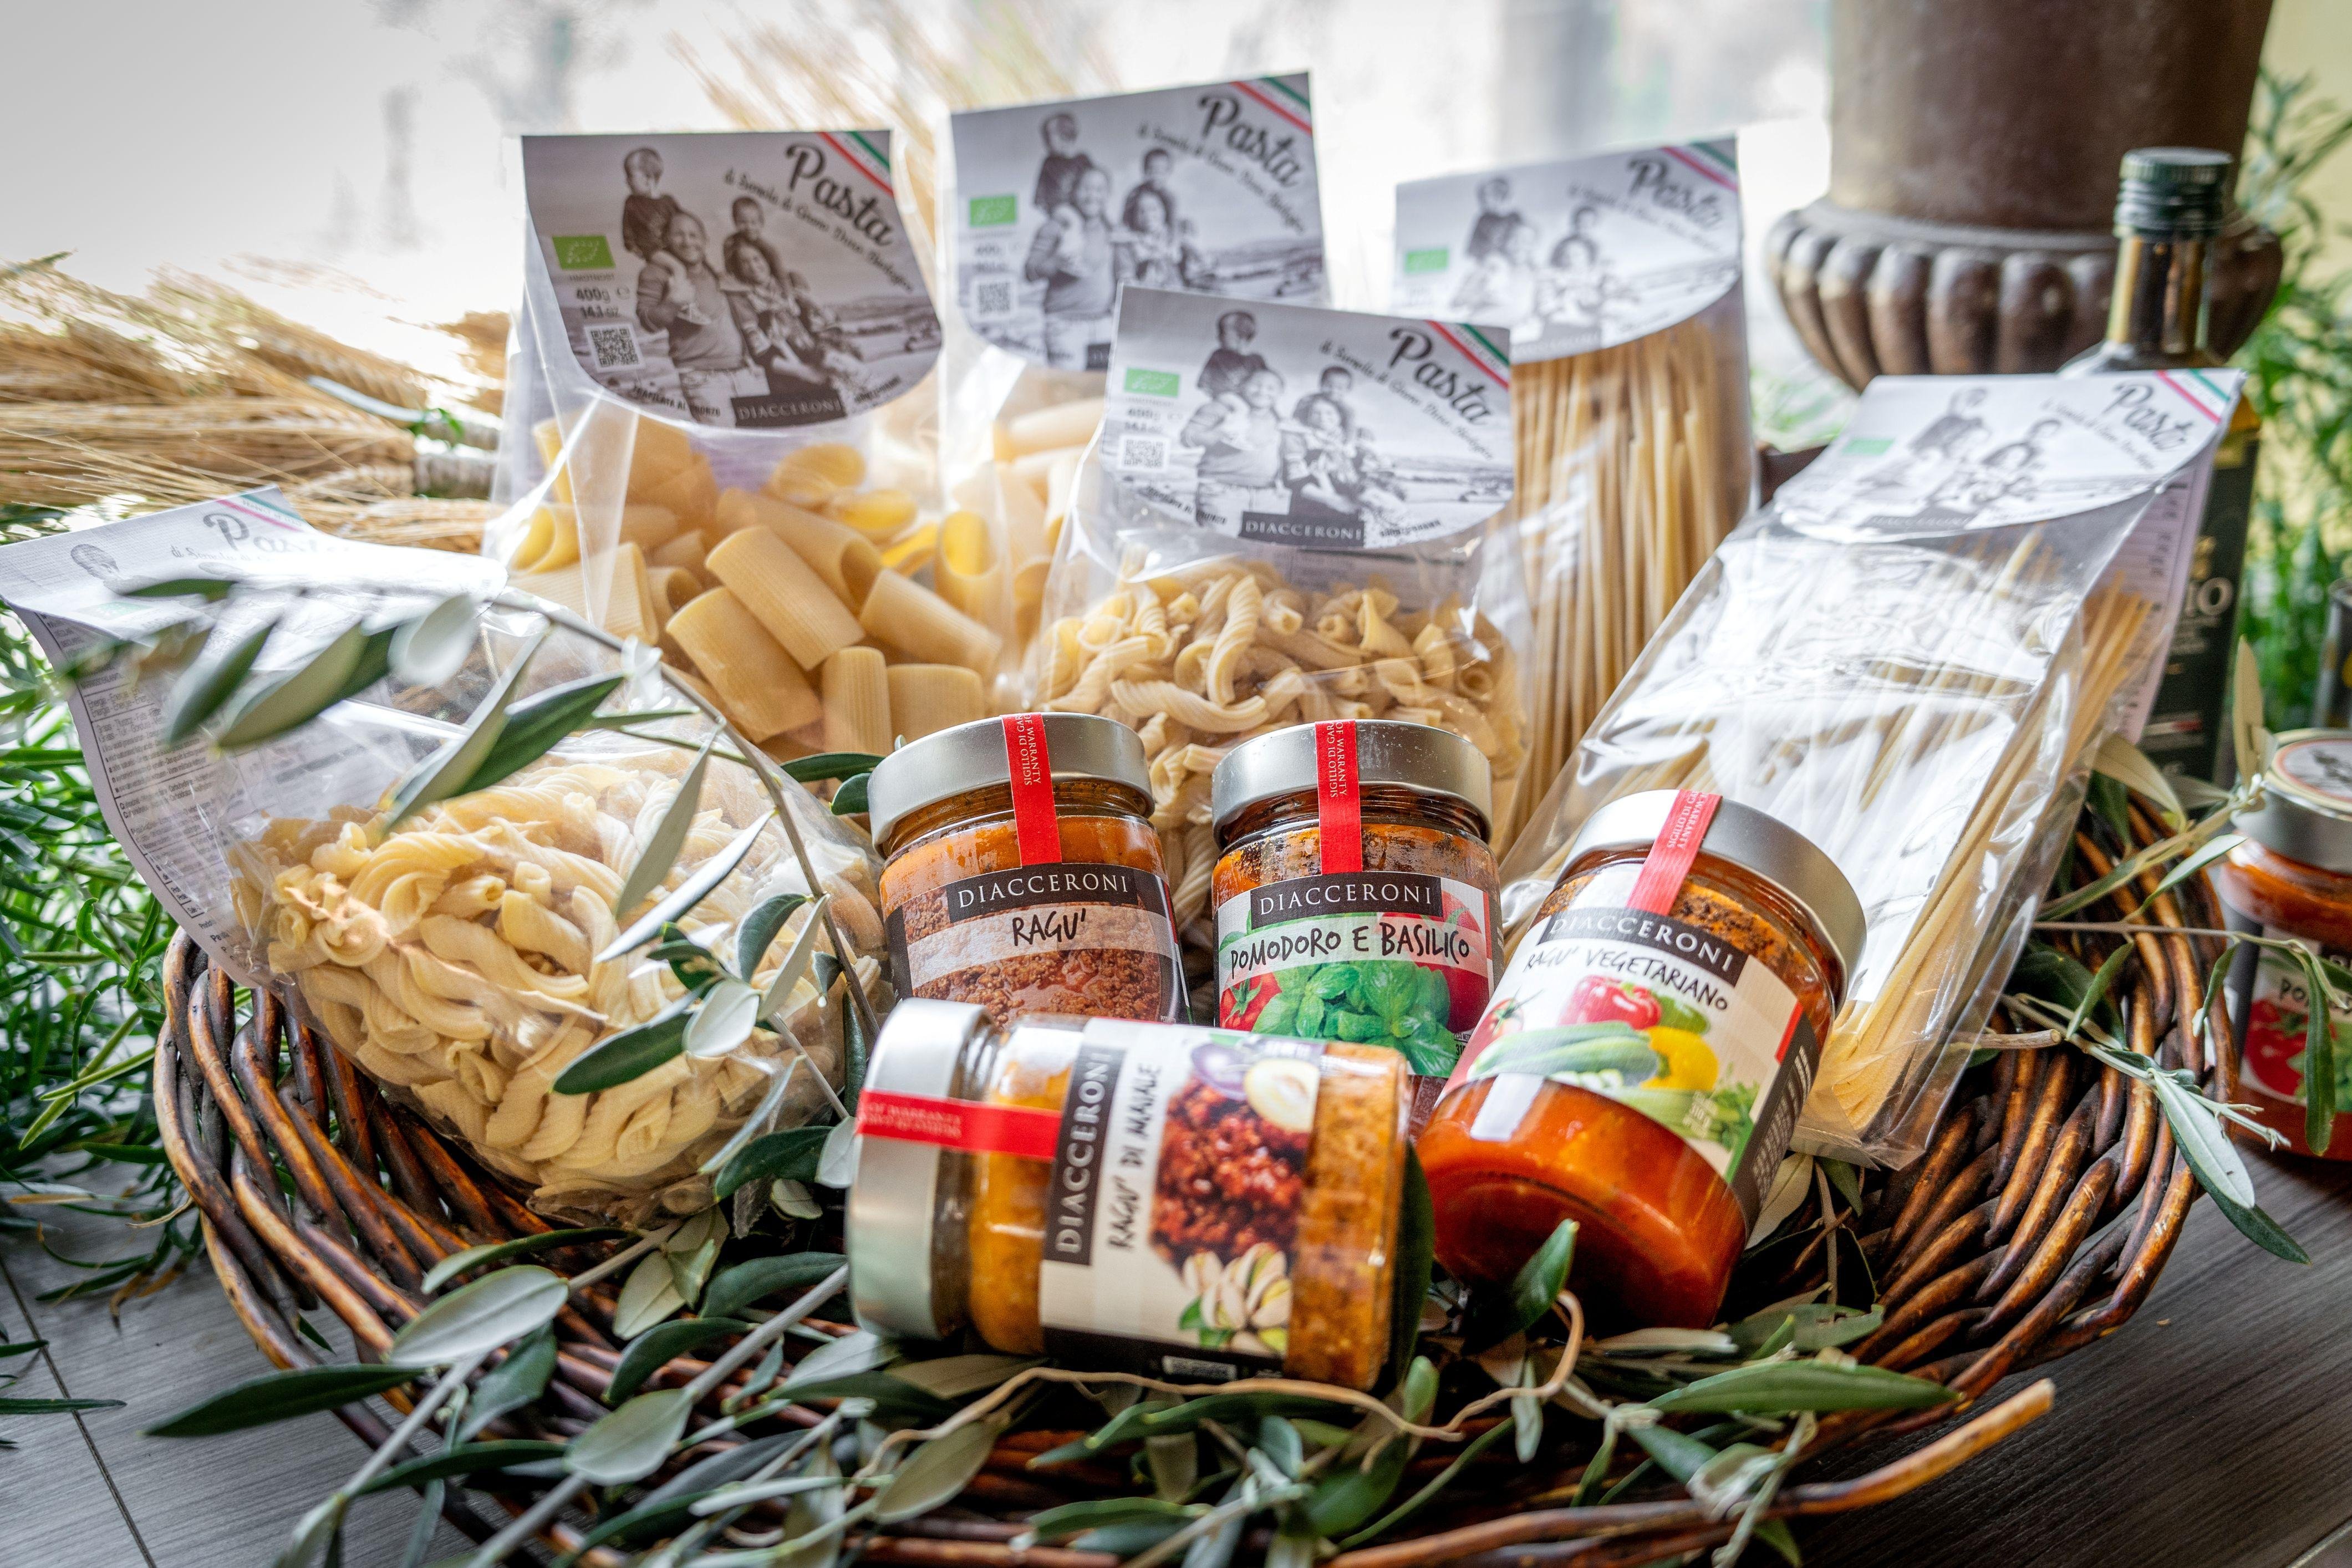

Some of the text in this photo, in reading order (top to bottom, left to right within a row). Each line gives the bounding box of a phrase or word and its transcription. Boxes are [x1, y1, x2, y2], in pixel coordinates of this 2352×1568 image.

[1198, 94, 1302, 187] Pasta
[785, 142, 893, 246] Pasta
[1389, 328, 1492, 426] Pasta
[737, 398, 841, 420] DIACCERONI
[2101, 381, 2193, 450] Pasta
[1245, 520, 1362, 540] DIACCERONI
[1019, 735, 1027, 745] DI
[1024, 714, 1041, 783] OF WARRANTY
[1328, 747, 1336, 757] DI
[1336, 722, 1347, 795] OF WARRANTY
[1020, 749, 1032, 785] SIGILLO
[1328, 761, 1338, 797] SIGILLO
[1667, 817, 1686, 848] SIGILLO
[1682, 806, 1692, 816] DI
[1677, 801, 1705, 850] WARRANTY
[959, 873, 1129, 909] DIACCERONI
[1260, 883, 1432, 915] DIACCERONI
[1012, 908, 1086, 946] RAGU'
[1230, 922, 1469, 978] POMODORO E BASILICO
[1549, 915, 1733, 973] DIACCERONI
[1586, 949, 1728, 1010] VEGETARIANO
[1126, 1063, 1161, 1140] MAIALE
[1055, 1053, 1113, 1253] DIACCERONI
[1120, 1145, 1146, 1167] DI
